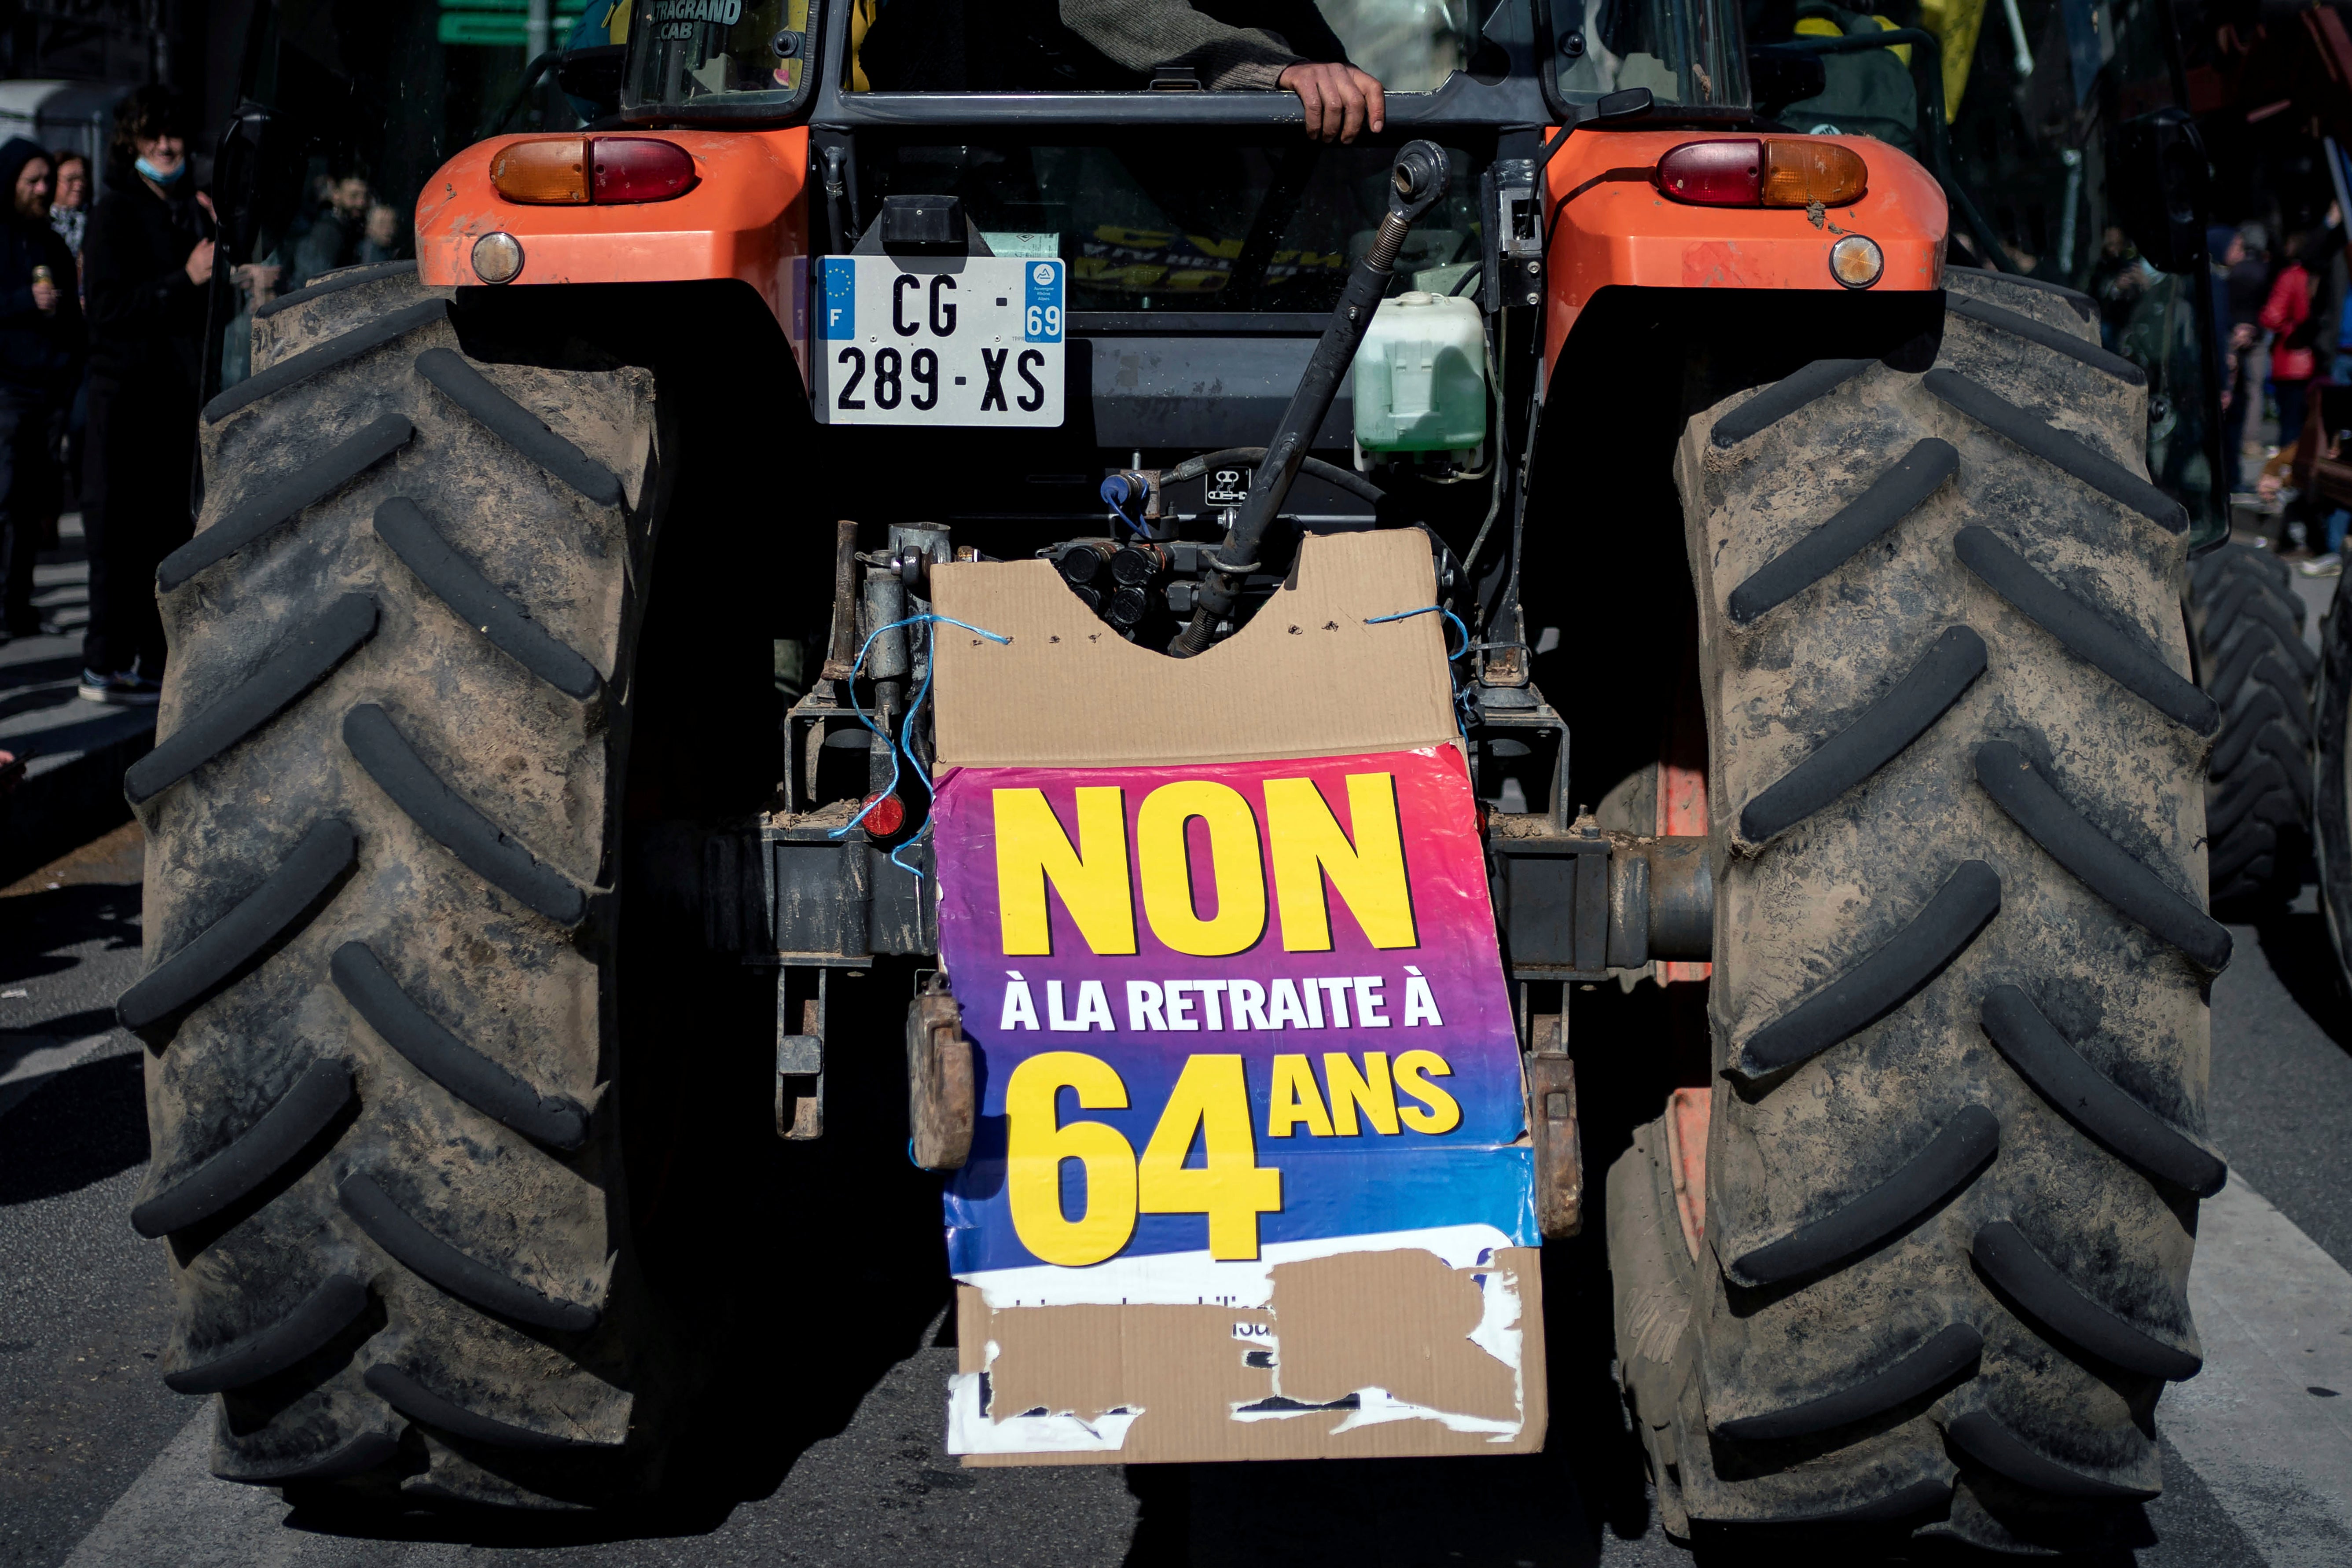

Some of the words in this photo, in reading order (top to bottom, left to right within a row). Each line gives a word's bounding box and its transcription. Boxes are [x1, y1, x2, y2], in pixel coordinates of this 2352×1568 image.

[651, 0, 742, 25] LTRAGRAND
[660, 22, 693, 40] CAB
[830, 308, 843, 327] F
[893, 274, 956, 337] CG
[1027, 305, 1061, 336] 69
[993, 772, 1418, 957] NON
[1000, 971, 1041, 1031] À
[1047, 980, 1117, 1032] LA
[1126, 975, 1392, 1032] RETRAITE
[1403, 966, 1444, 1027] À
[1006, 1051, 1282, 1267] 64
[1268, 1050, 1462, 1137] ANS
